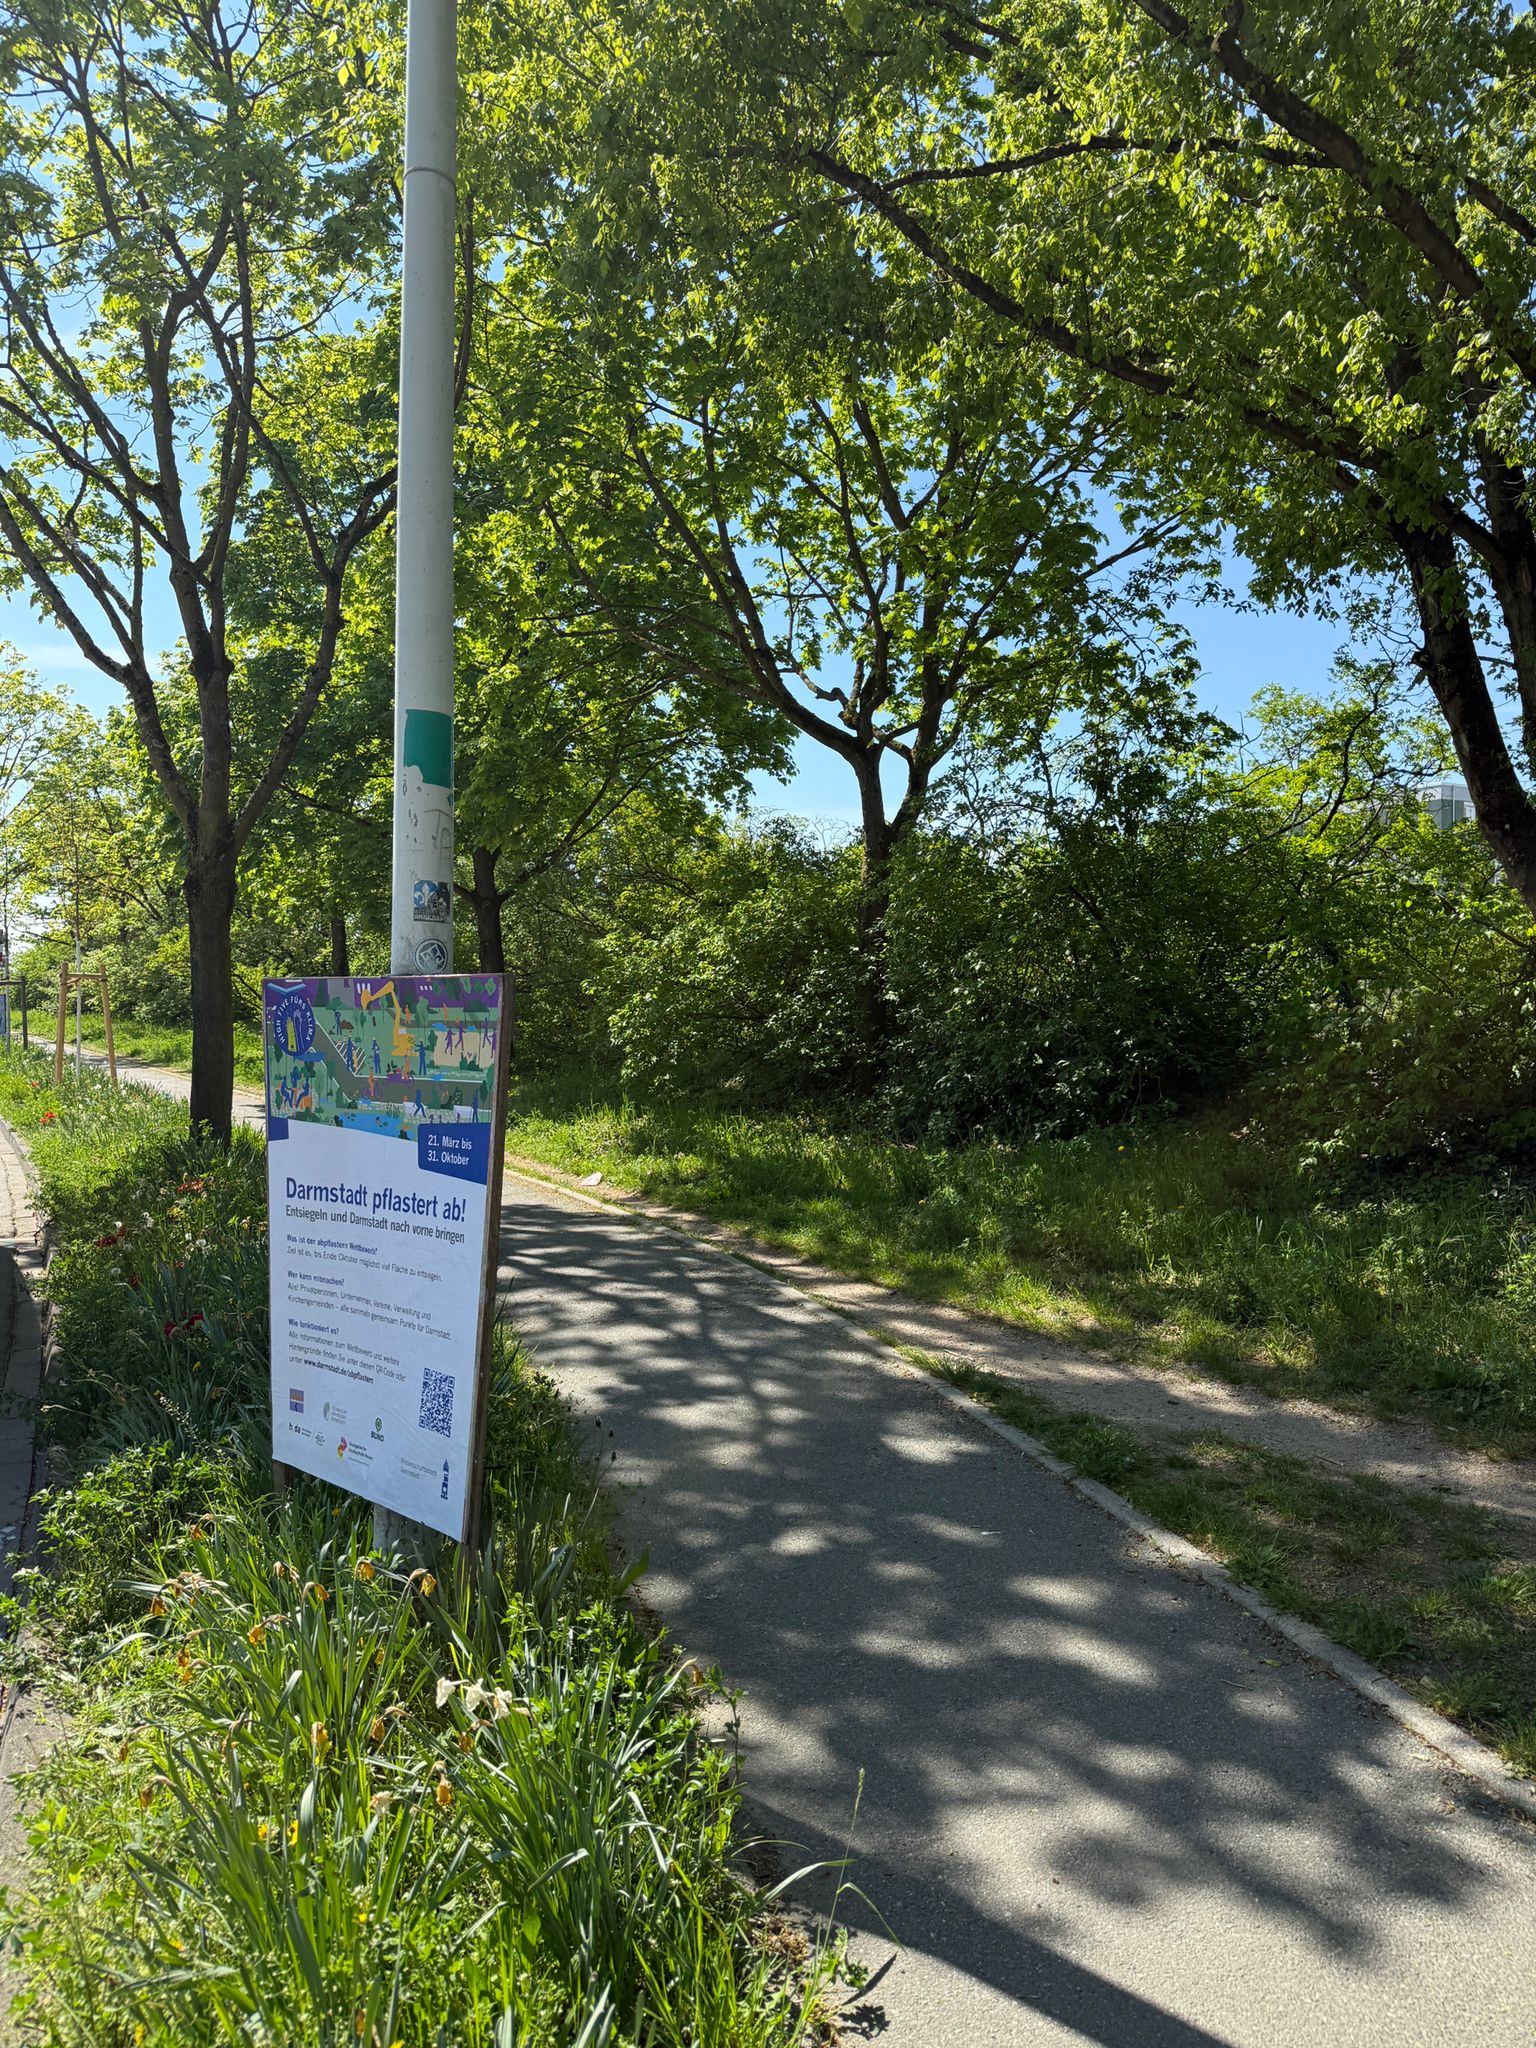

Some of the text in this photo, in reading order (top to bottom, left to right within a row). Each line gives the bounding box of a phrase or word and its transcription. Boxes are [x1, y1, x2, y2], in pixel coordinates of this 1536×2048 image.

[276, 995, 314, 1044] HIGH FIVE FÜRS KLIMA
[428, 1135, 472, 1150] 21. März bis
[428, 1150, 470, 1166] 31. Oktober
[286, 1177, 466, 1222] Darmstadt pflastert ab!
[286, 1205, 465, 1245] Entsiegeln und Darmstadt nach vorne bringen
[307, 1237, 316, 1245] der
[287, 1246, 296, 1254] Ziel
[314, 1251, 322, 1259] bis
[323, 1251, 337, 1261] Ende
[338, 1253, 358, 1263] Oktober
[288, 1270, 298, 1279] Wer
[299, 1272, 312, 1280] kann
[288, 1319, 298, 1327] Wie
